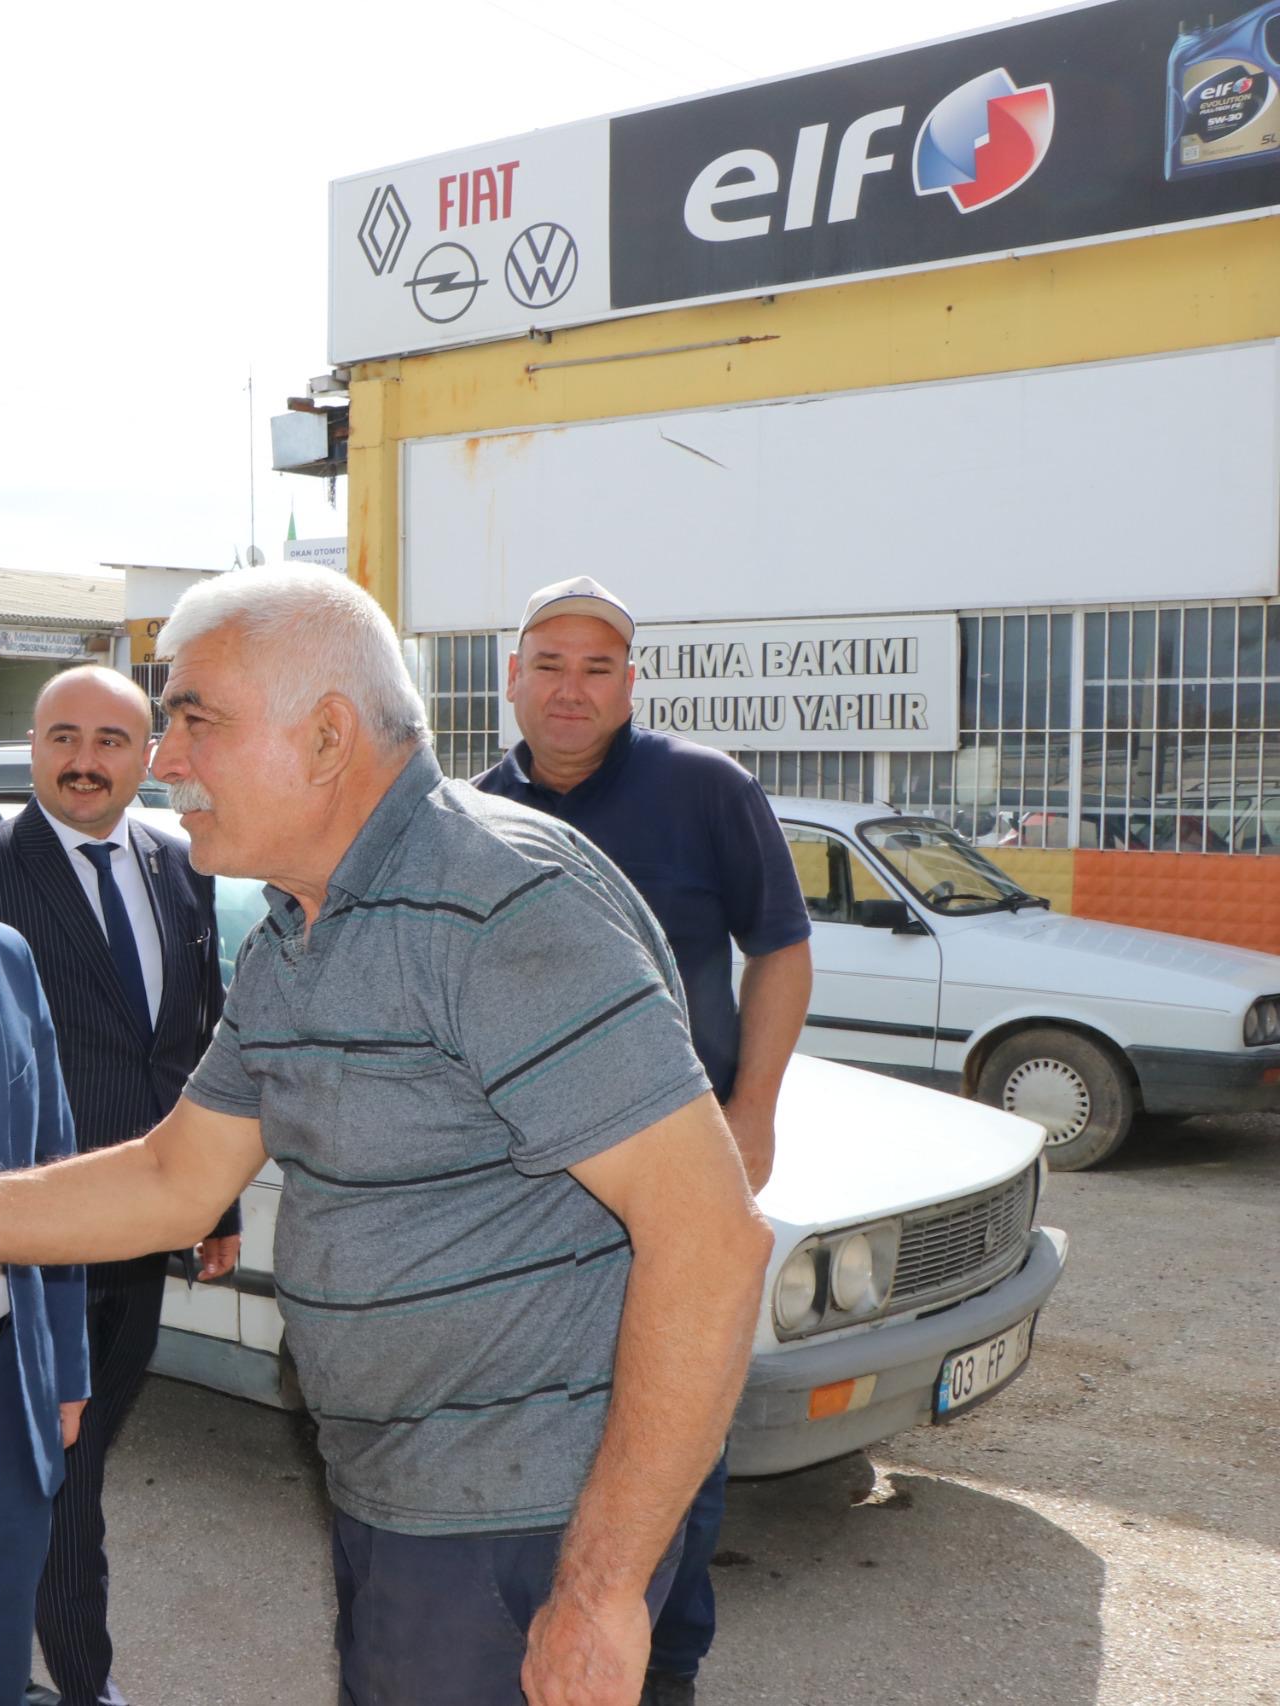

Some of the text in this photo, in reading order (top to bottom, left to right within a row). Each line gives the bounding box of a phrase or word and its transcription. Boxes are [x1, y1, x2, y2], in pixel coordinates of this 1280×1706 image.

[1199, 92, 1252, 110] EVOLUTION
[1200, 81, 1233, 100] elf
[1207, 112, 1243, 126] 5W-30
[683, 107, 904, 242] elf
[439, 160, 520, 232] FIAT
[290, 548, 312, 558] OKAN
[762, 636, 919, 678] BAKIMI
[653, 696, 786, 732] DOLUMU
[793, 693, 929, 732] YAPILIR
[952, 1355, 975, 1401] 03
[986, 1339, 1006, 1385] FP
